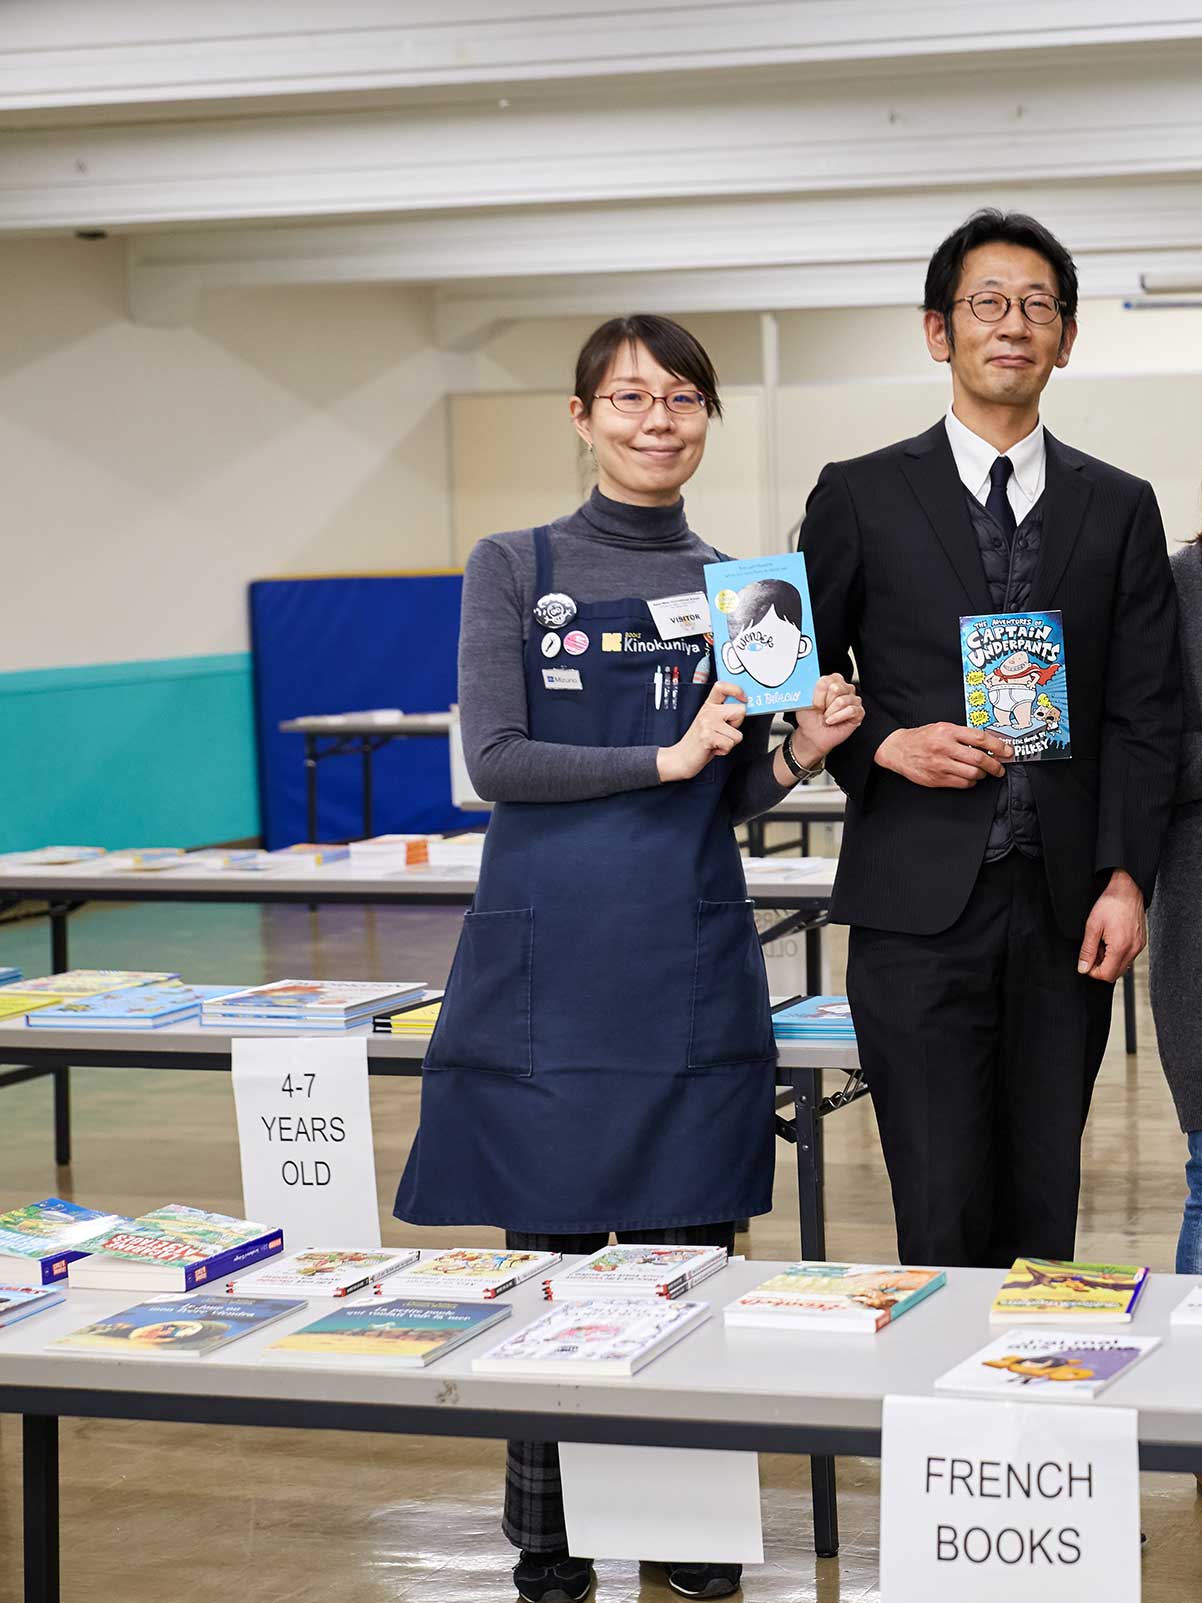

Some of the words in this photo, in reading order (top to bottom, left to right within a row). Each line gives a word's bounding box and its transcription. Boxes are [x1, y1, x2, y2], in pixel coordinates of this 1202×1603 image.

[669, 613, 702, 624] VISITOR
[973, 621, 987, 629] THE
[992, 618, 1032, 626] ADVENTURES
[624, 637, 701, 655] Kinokuniya
[968, 640, 1060, 667] UNDERPANTS
[281, 1073, 317, 1099] 4-7
[261, 1116, 346, 1143] YEARS
[281, 1160, 331, 1186] OLD
[925, 1456, 1094, 1499] FRENCH
[936, 1525, 1081, 1565] BOOKS
